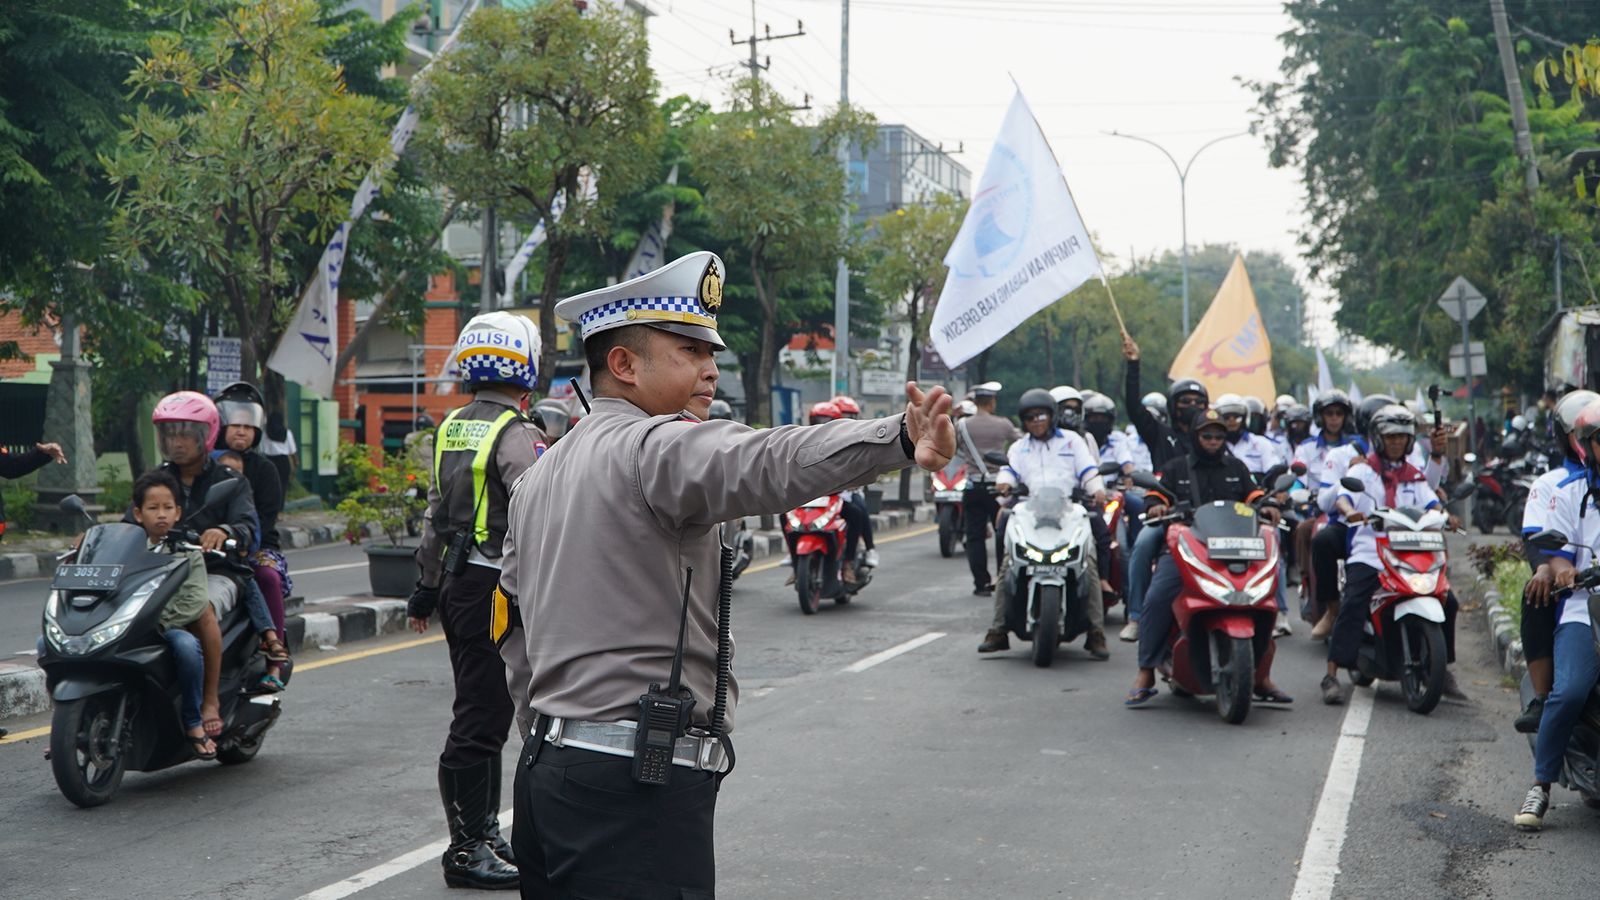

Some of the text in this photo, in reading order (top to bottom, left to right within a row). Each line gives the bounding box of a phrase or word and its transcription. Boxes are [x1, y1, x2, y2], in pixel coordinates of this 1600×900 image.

[460, 332, 509, 347] POLISI
[446, 422, 490, 438] GIRI SPEED
[446, 440, 457, 448] TIM
[60, 567, 120, 577] W 3092 D
